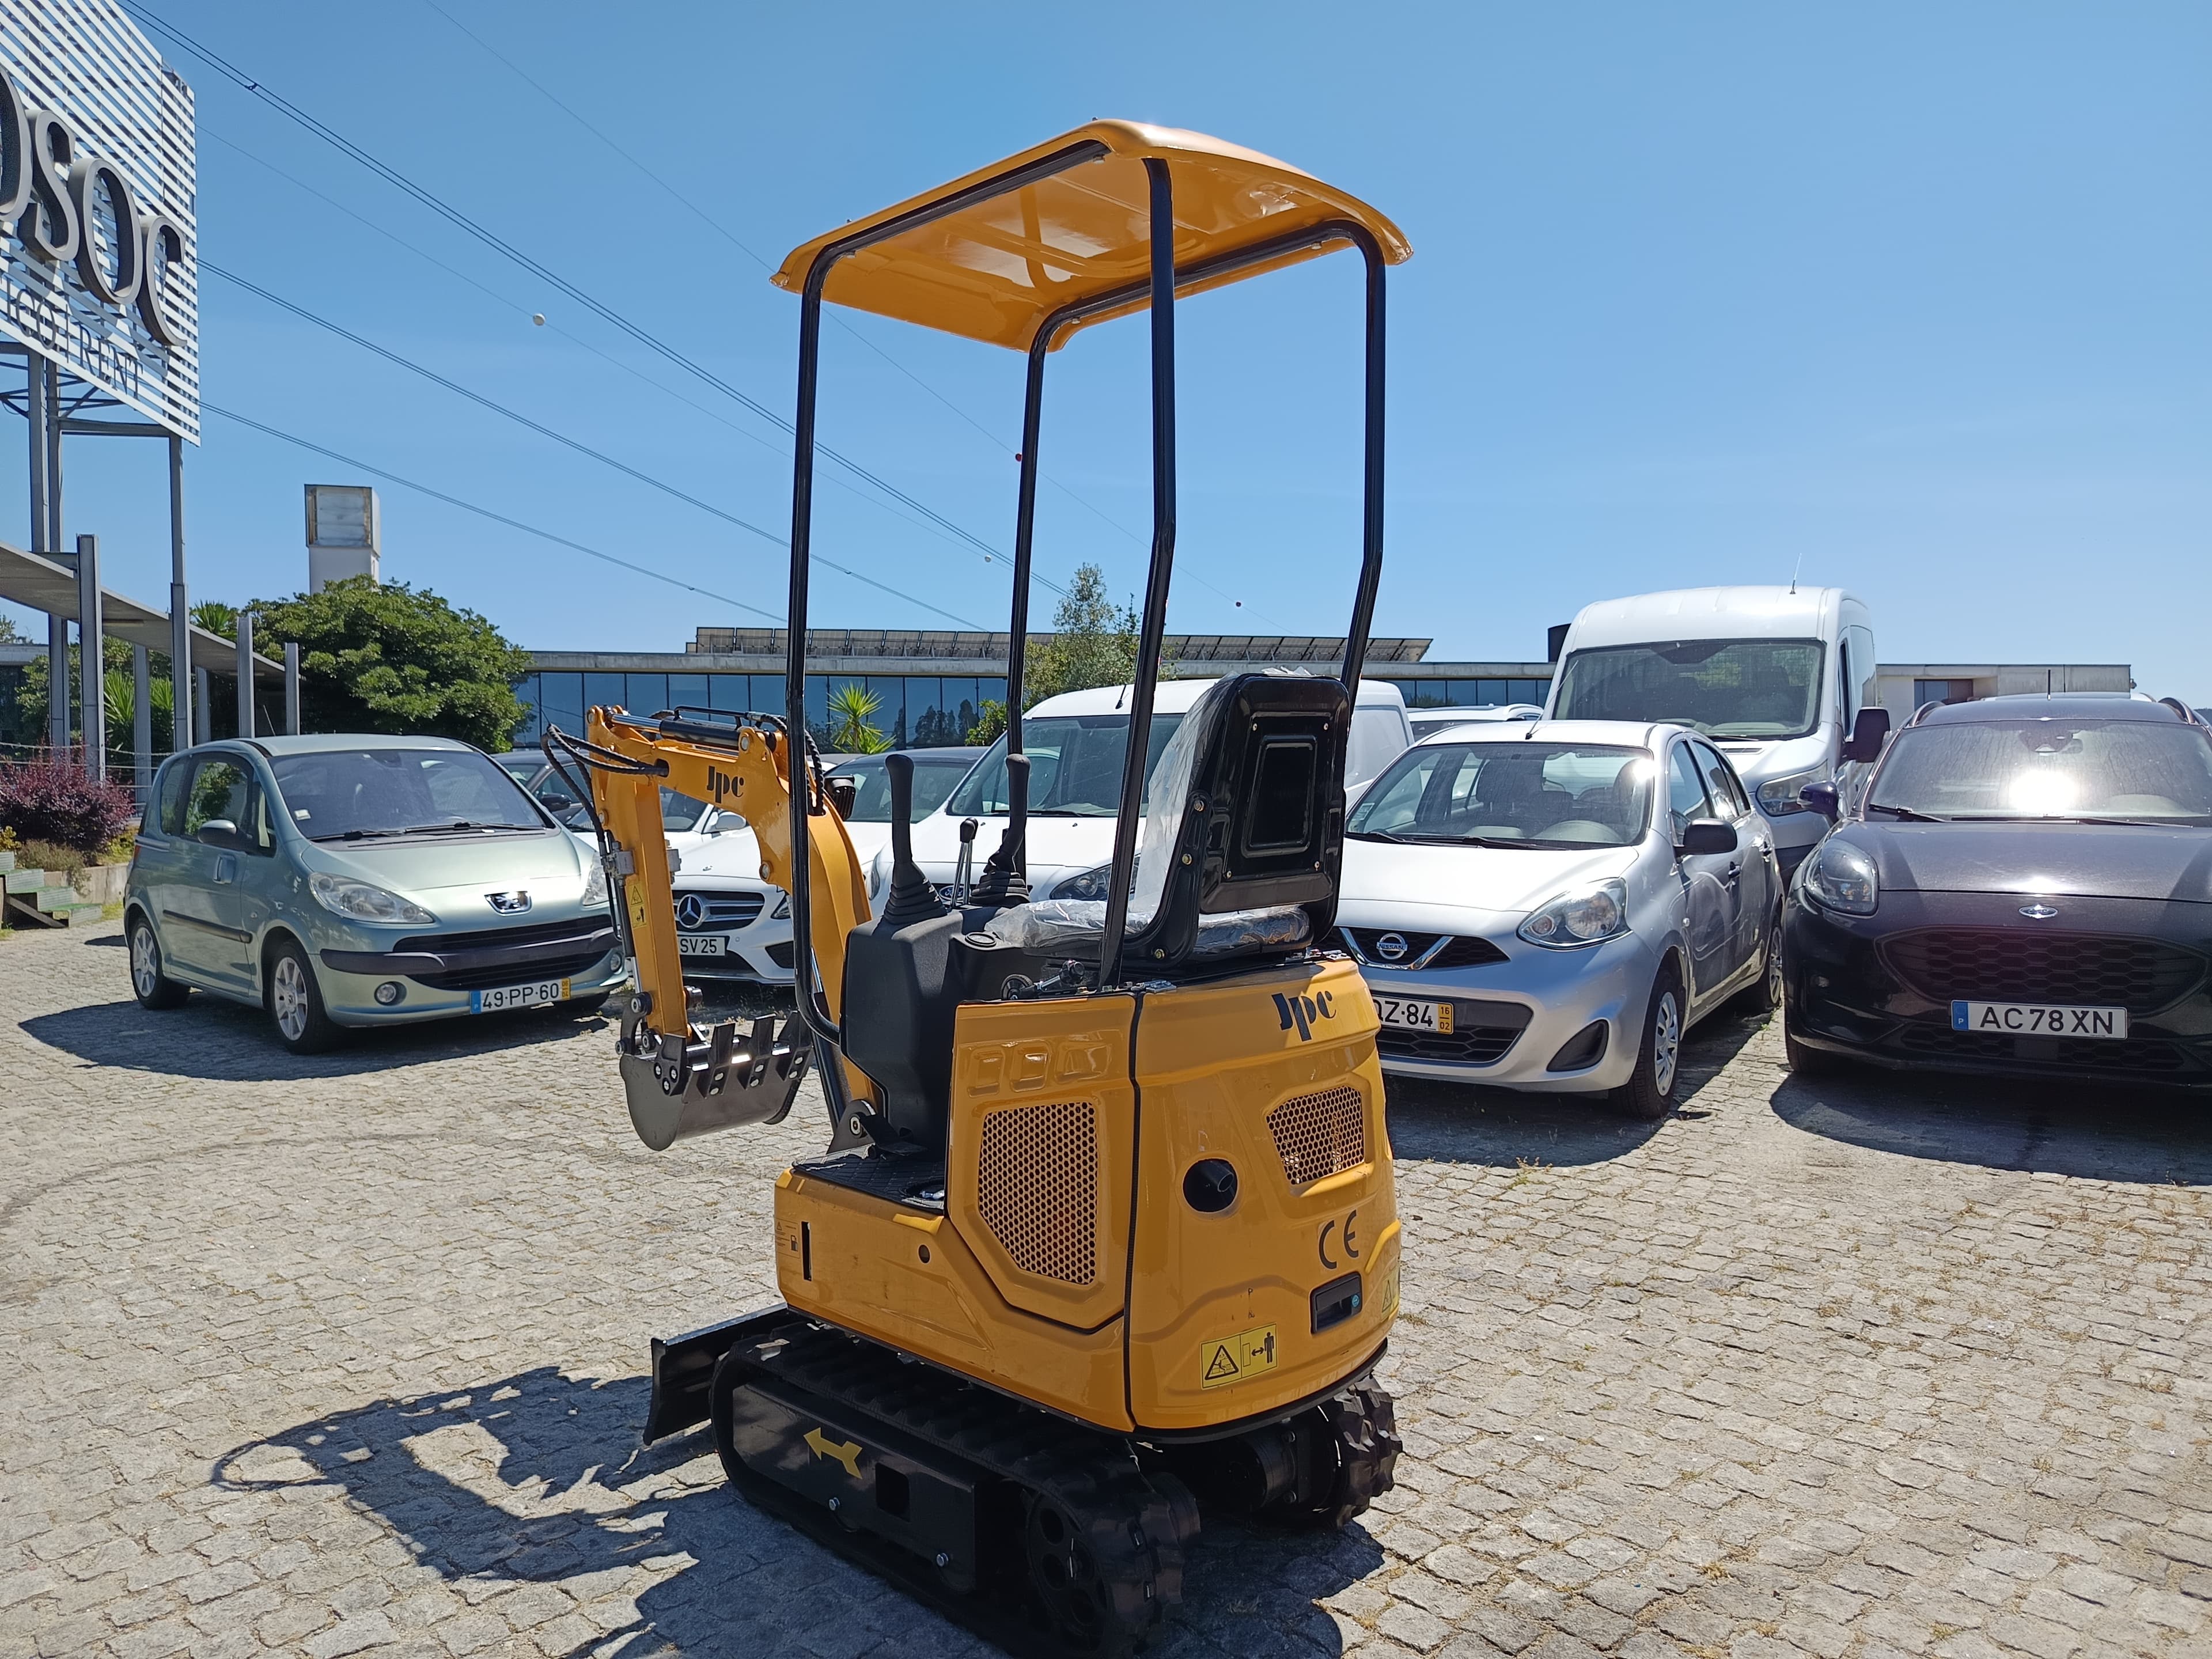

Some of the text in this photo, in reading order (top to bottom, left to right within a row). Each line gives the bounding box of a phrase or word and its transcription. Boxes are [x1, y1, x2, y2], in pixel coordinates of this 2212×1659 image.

[72, 323, 143, 402] RENT
[1440, 1022, 1449, 1030] 02
[1441, 1006, 1449, 1014] 16
[1319, 1210, 1359, 1269] CE
